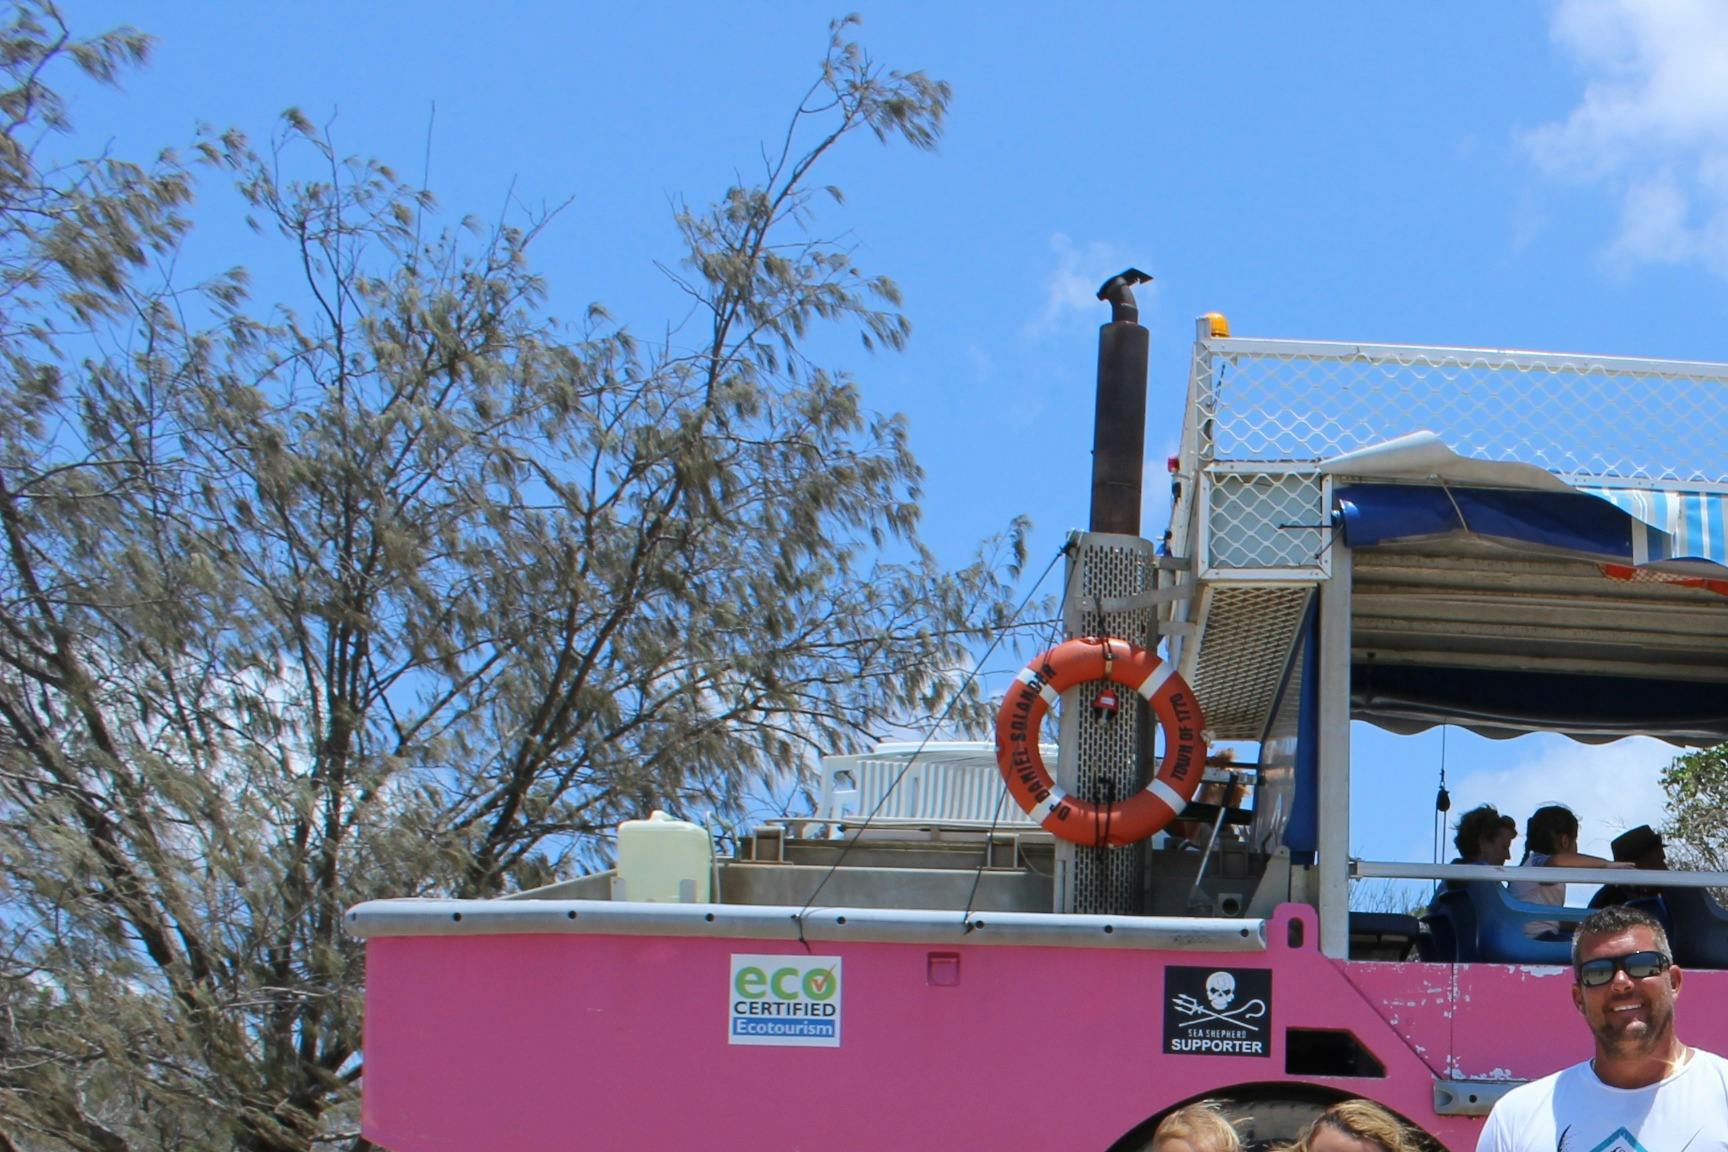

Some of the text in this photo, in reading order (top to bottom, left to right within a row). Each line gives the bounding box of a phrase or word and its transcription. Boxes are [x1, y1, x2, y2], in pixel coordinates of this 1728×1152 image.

[1010, 663, 1056, 742] SOLANDER
[1179, 726, 1193, 741] OF
[1169, 745, 1194, 781] TOWN
[1013, 749, 1051, 804] DANIEL
[734, 965, 837, 1001] eco
[733, 1001, 837, 1017] CERTIFIED
[736, 1019, 833, 1035] Ecotourism
[1188, 1029, 1247, 1039] SEA SHEPHERD
[1171, 1039, 1262, 1053] SUPPORTER
